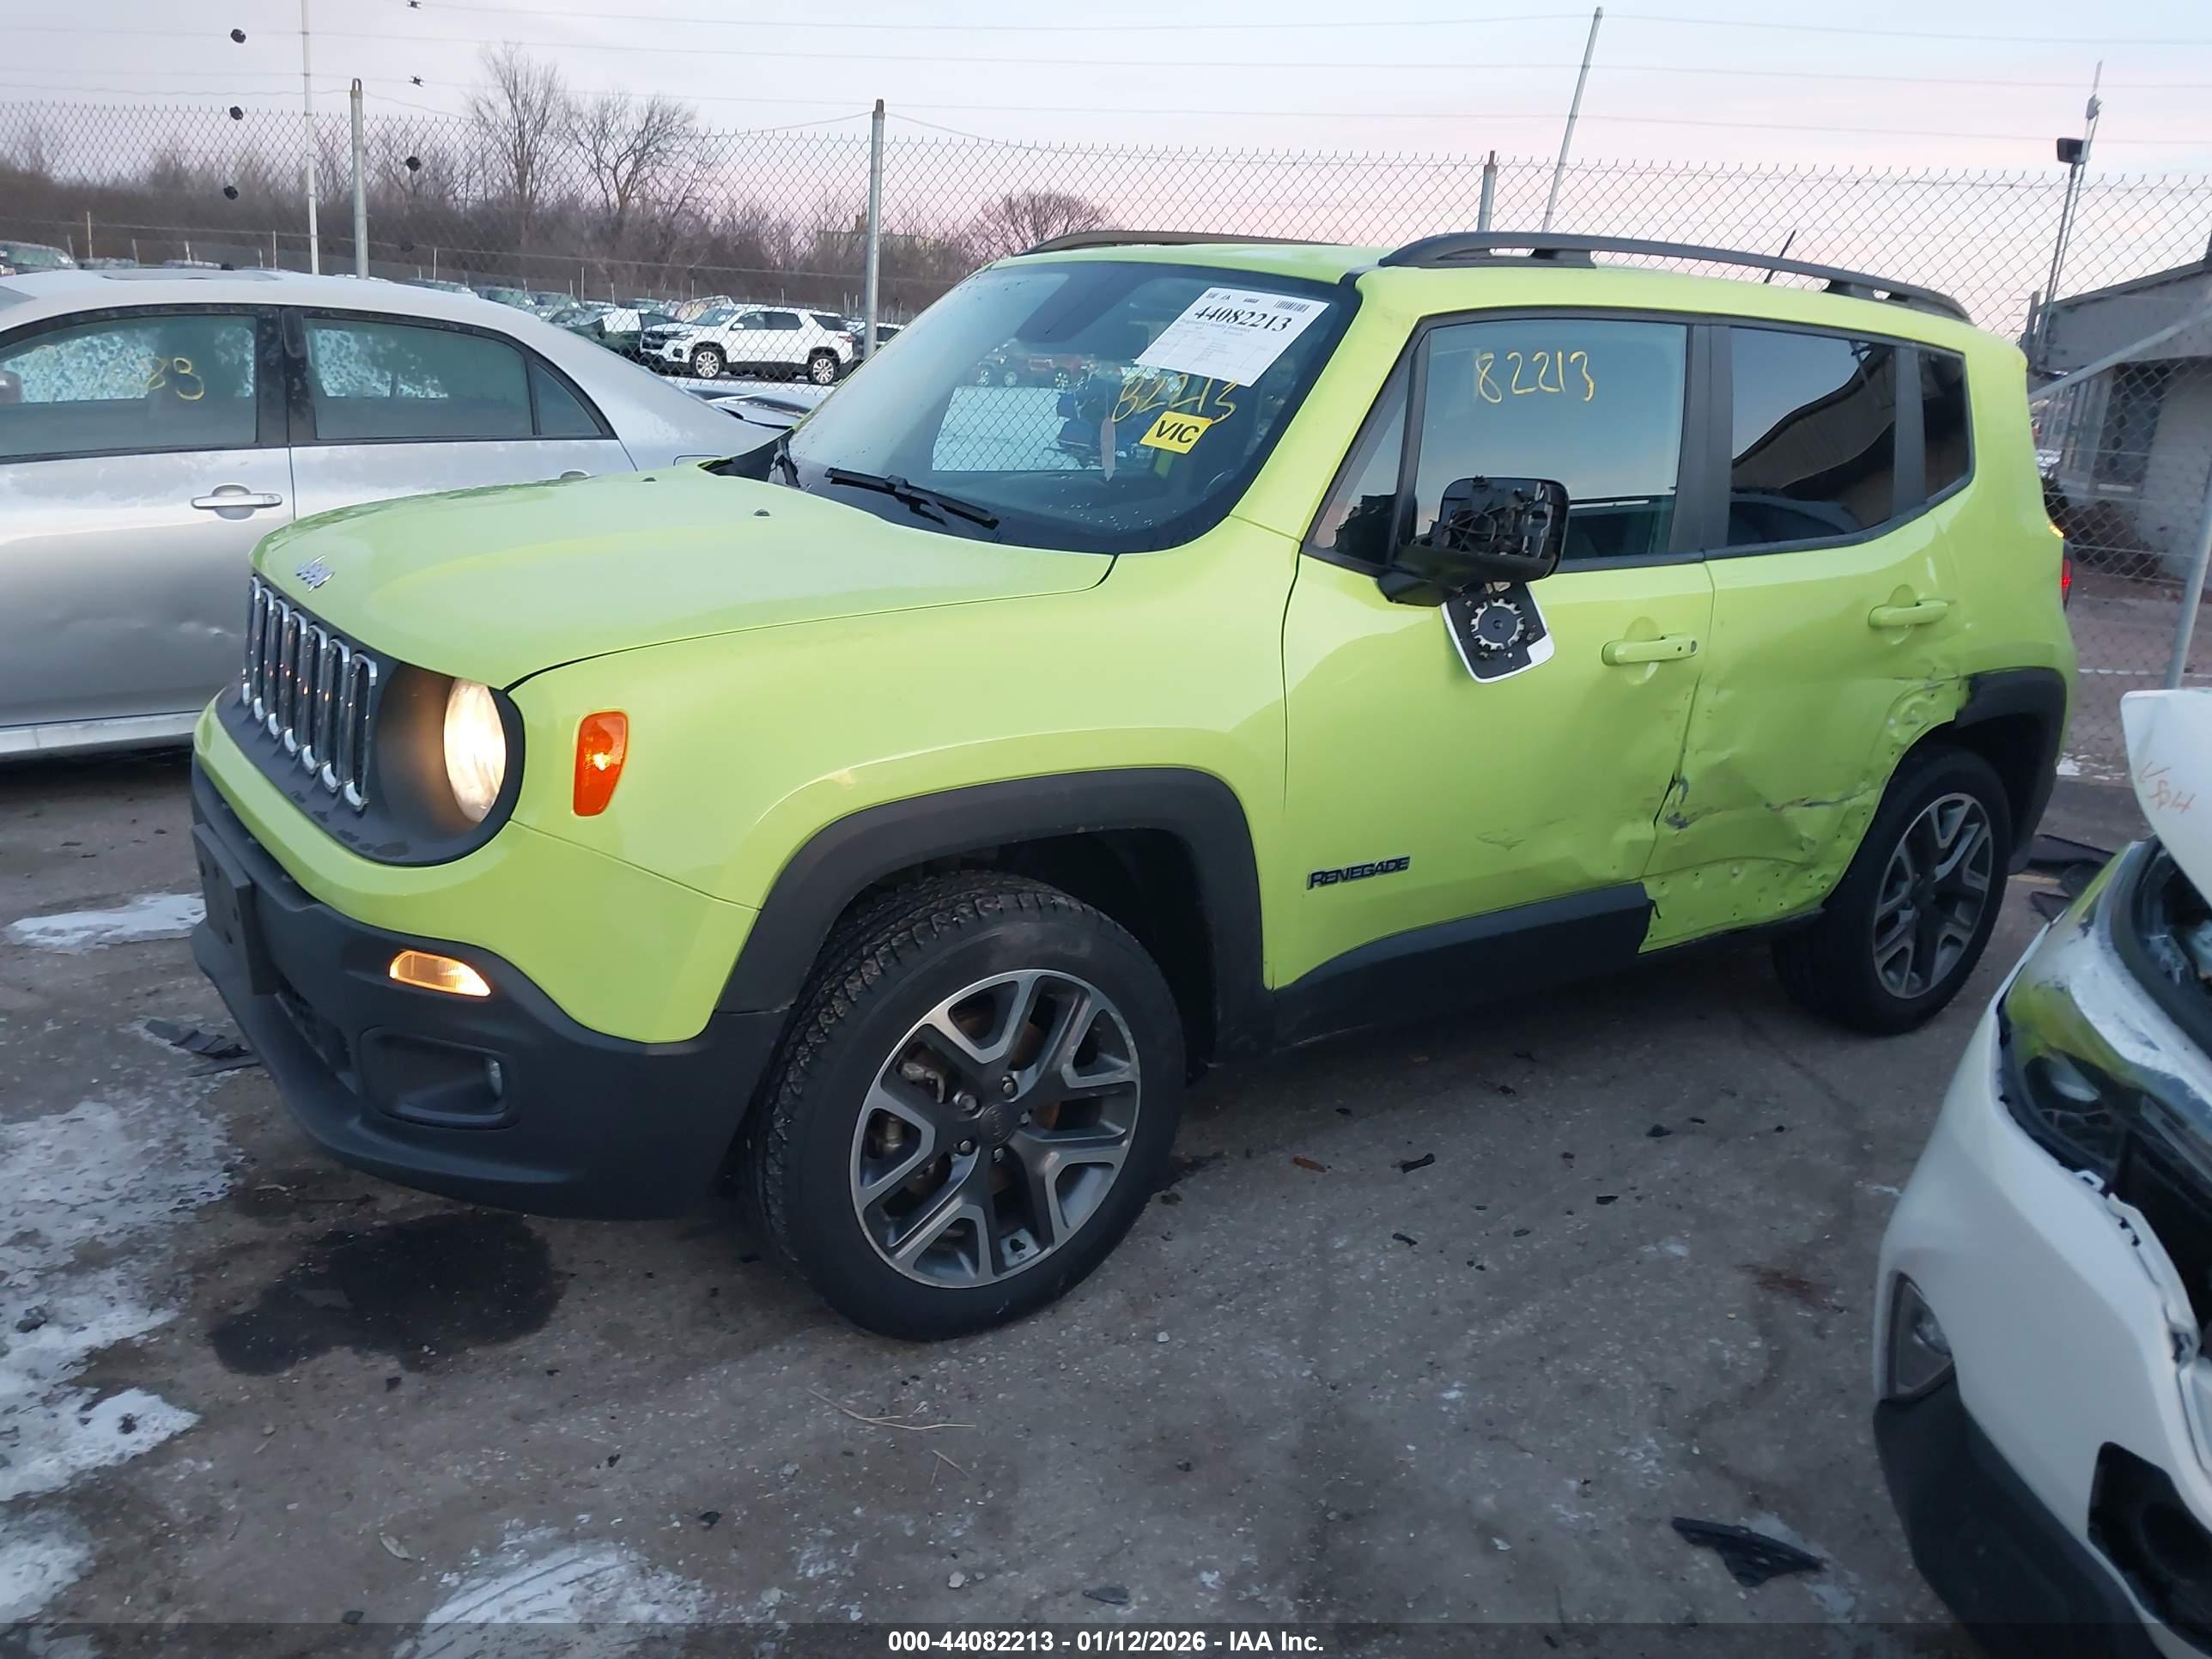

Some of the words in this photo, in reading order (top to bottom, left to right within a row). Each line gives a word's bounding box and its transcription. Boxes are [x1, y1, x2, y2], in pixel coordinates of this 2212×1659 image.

[1194, 305, 1292, 332] 44082213
[1475, 350, 1595, 404] 82213
[1156, 420, 1200, 443] VIC
[1306, 856, 1411, 890] RENEGADE
